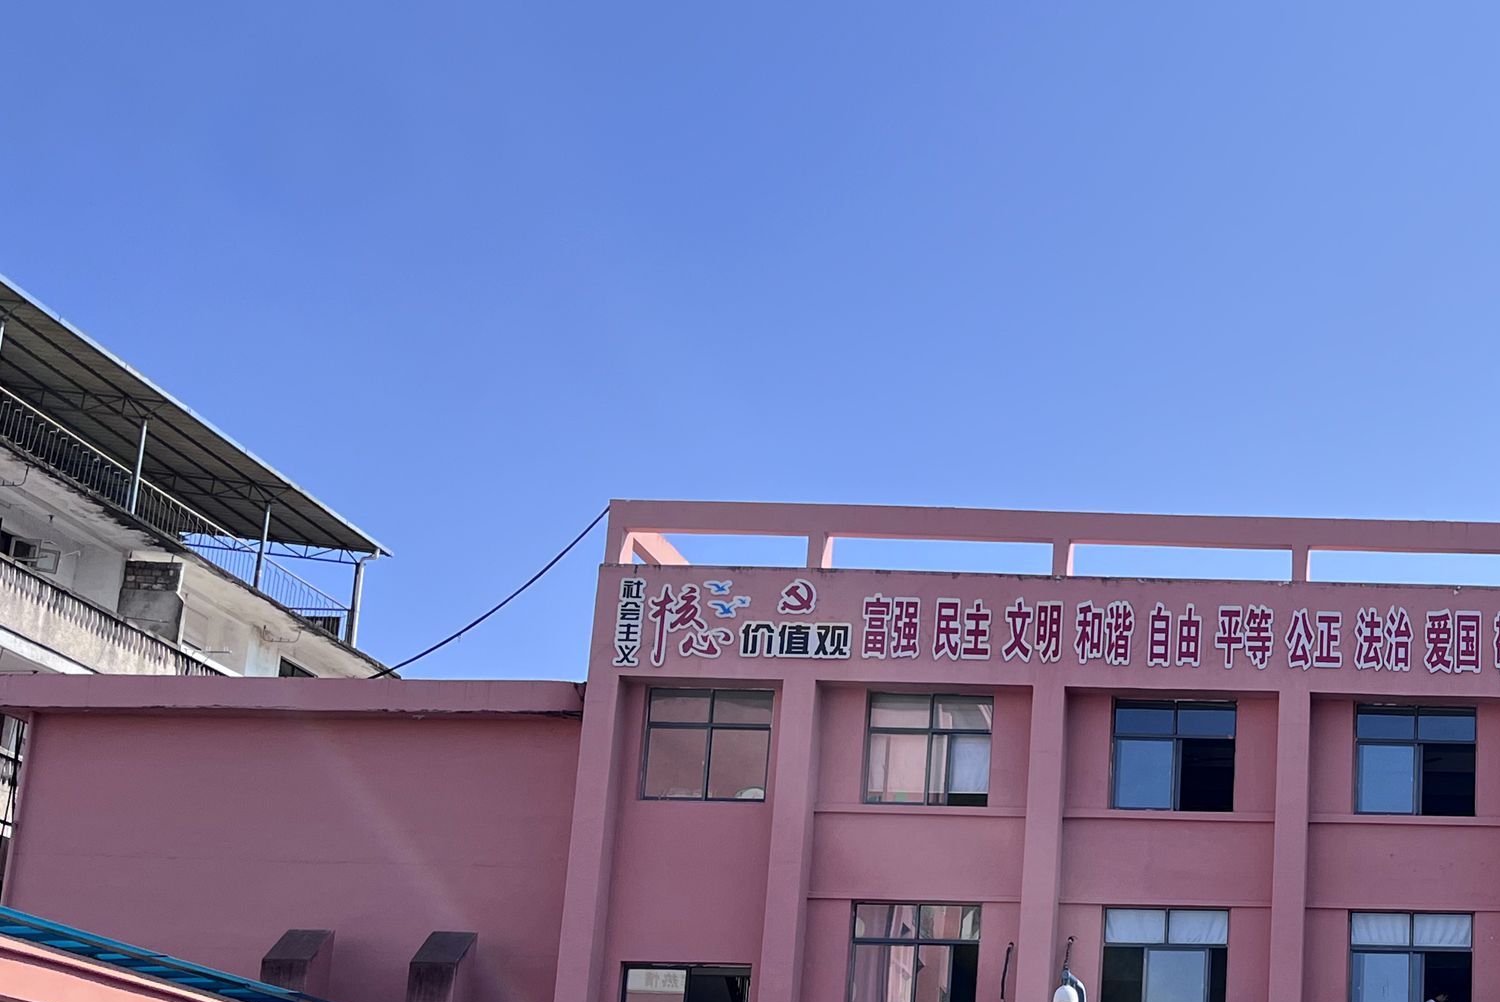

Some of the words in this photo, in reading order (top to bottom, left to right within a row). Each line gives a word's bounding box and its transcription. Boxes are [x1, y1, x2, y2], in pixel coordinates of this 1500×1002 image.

[615, 580, 644, 664] 社会主义
[651, 586, 732, 663] 核心
[742, 623, 849, 656] 价值观
[864, 599, 918, 655] 富强
[934, 603, 991, 657] 民主
[1004, 603, 1062, 659] 文明
[1076, 606, 1133, 661] 和谐
[1149, 607, 1200, 664] 自由
[1216, 609, 1273, 663] 平等
[1287, 612, 1340, 666] 公正
[1354, 611, 1412, 668] 法治
[1424, 613, 1480, 670] 爱国
